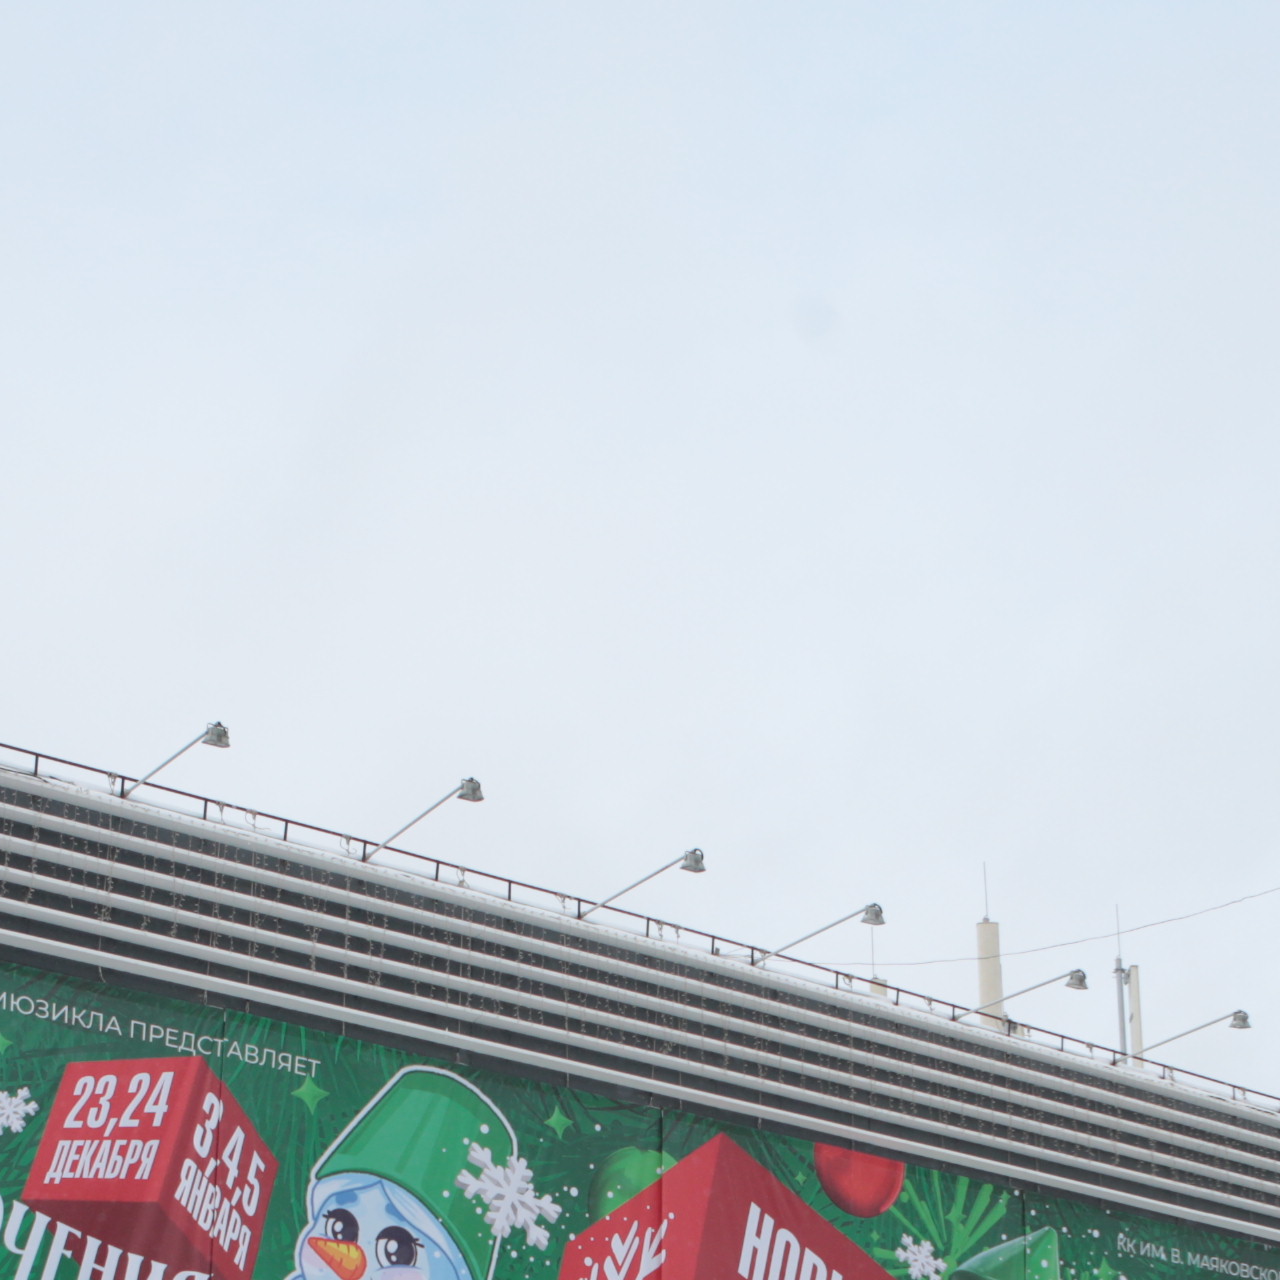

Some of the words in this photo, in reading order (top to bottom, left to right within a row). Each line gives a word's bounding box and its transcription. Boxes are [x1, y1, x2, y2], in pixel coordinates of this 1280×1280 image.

[130, 1019, 321, 1078] ПРЕДСТАВЛЯЕТ
[63, 1071, 174, 1137] 23,24
[43, 1139, 160, 1184] ДЕКАБРЯ
[174, 1158, 252, 1272] ЯНВАРЯ
[1171, 1248, 1184, 1265] В.
